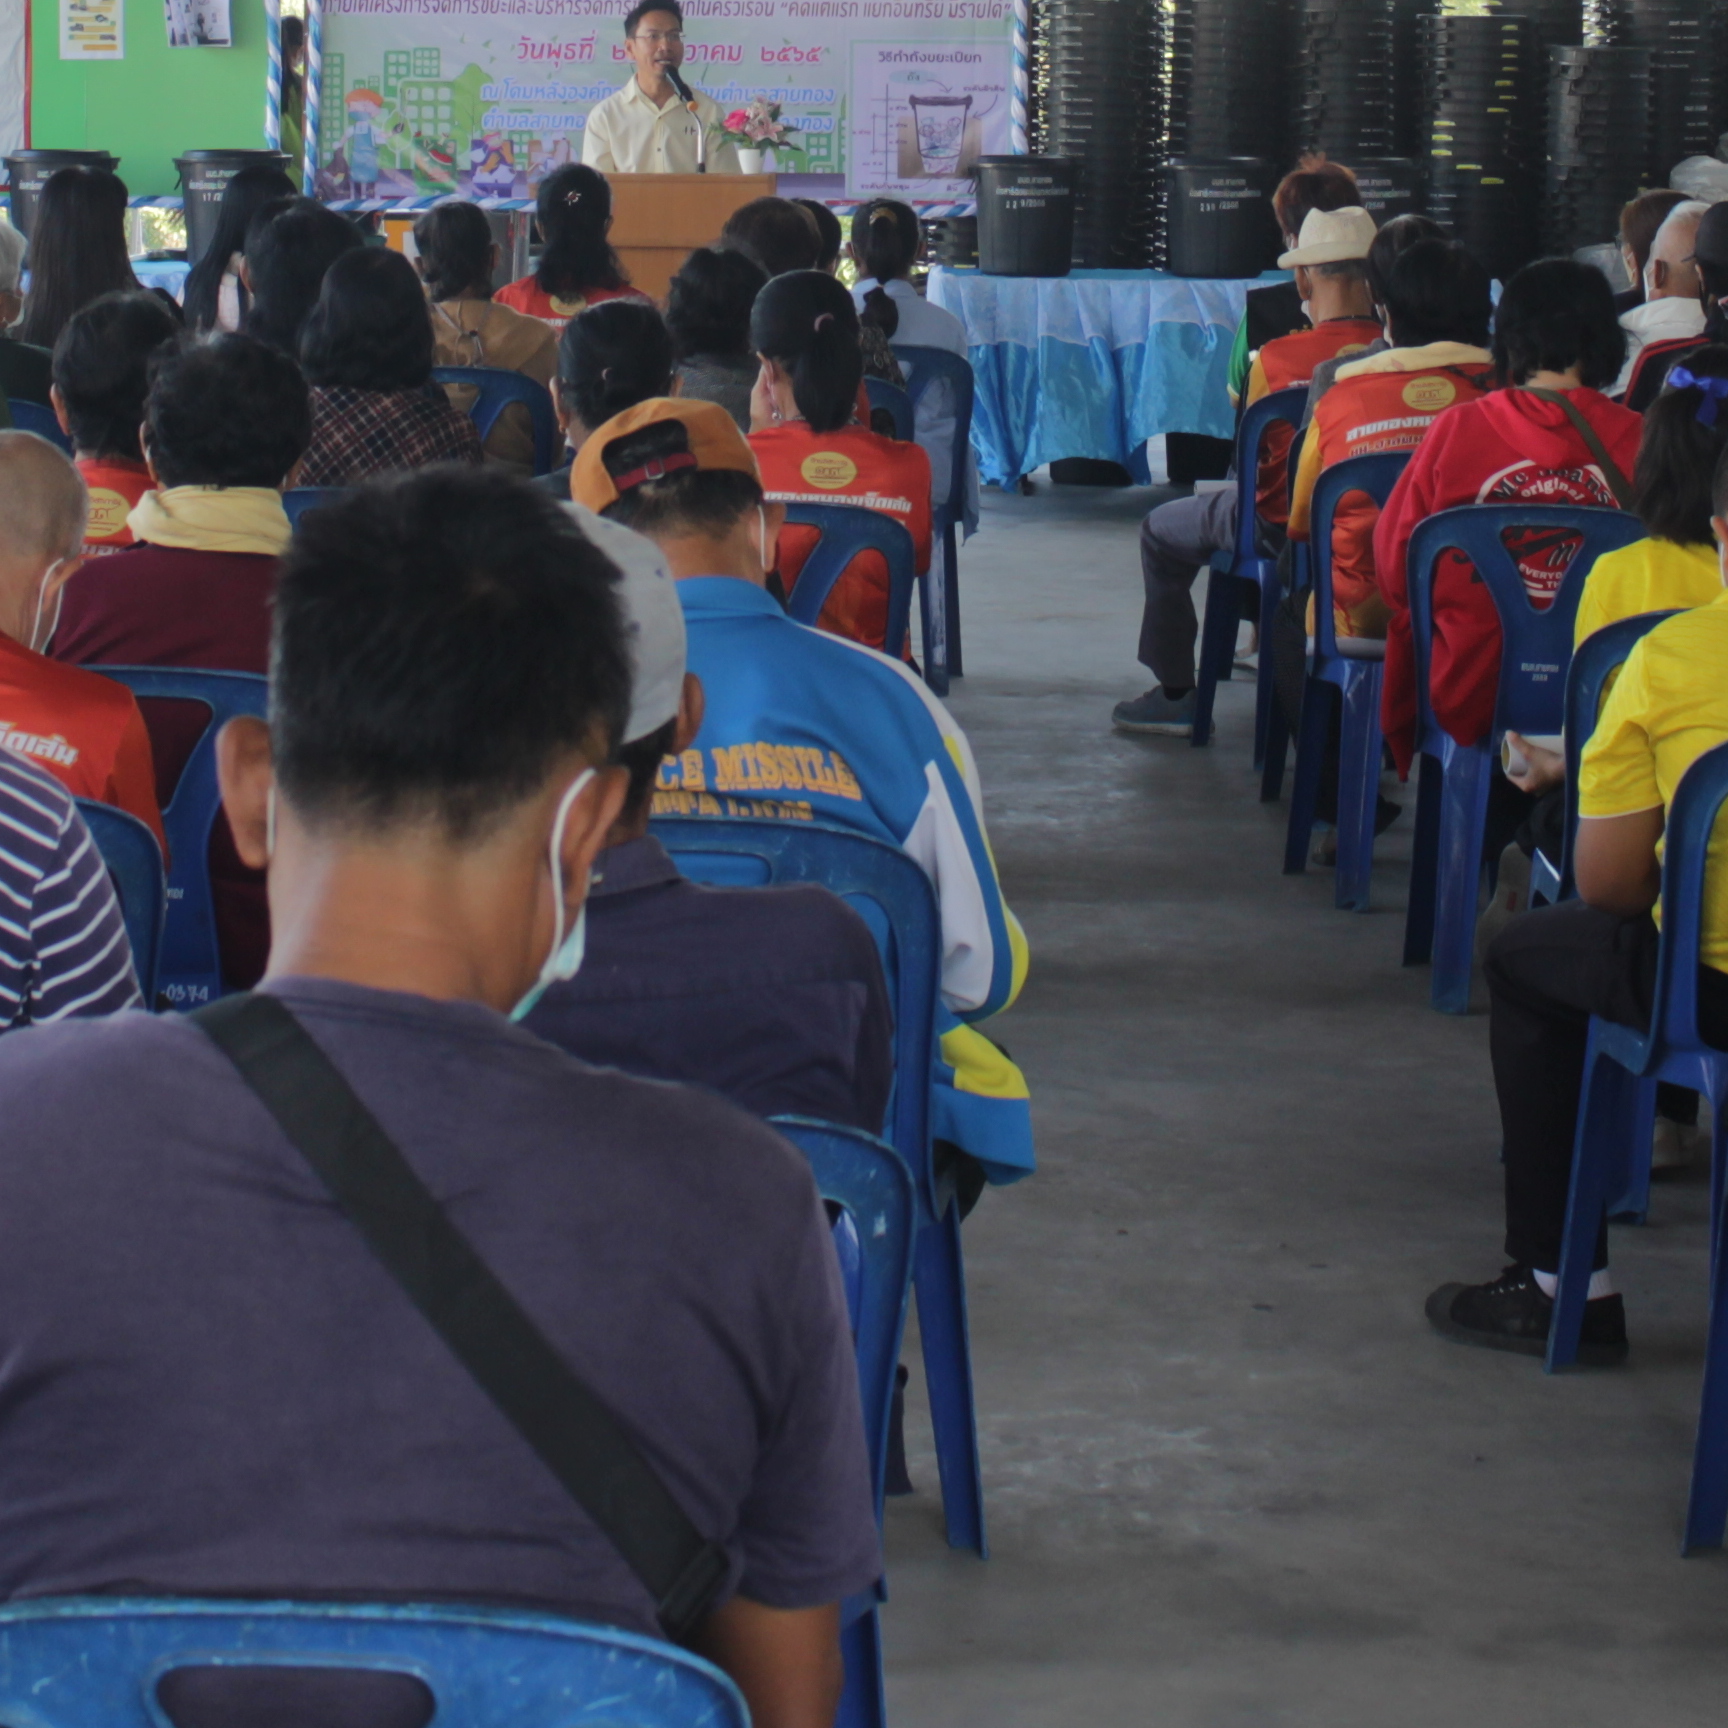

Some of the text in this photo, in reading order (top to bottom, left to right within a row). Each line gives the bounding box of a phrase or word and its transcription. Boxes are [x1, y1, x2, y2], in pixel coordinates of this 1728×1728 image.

[518, 30, 597, 68] วันพุธที่
[1521, 477, 1585, 501] original
[1518, 562, 1563, 580] EVERYD
[711, 741, 863, 801] MISSILE
